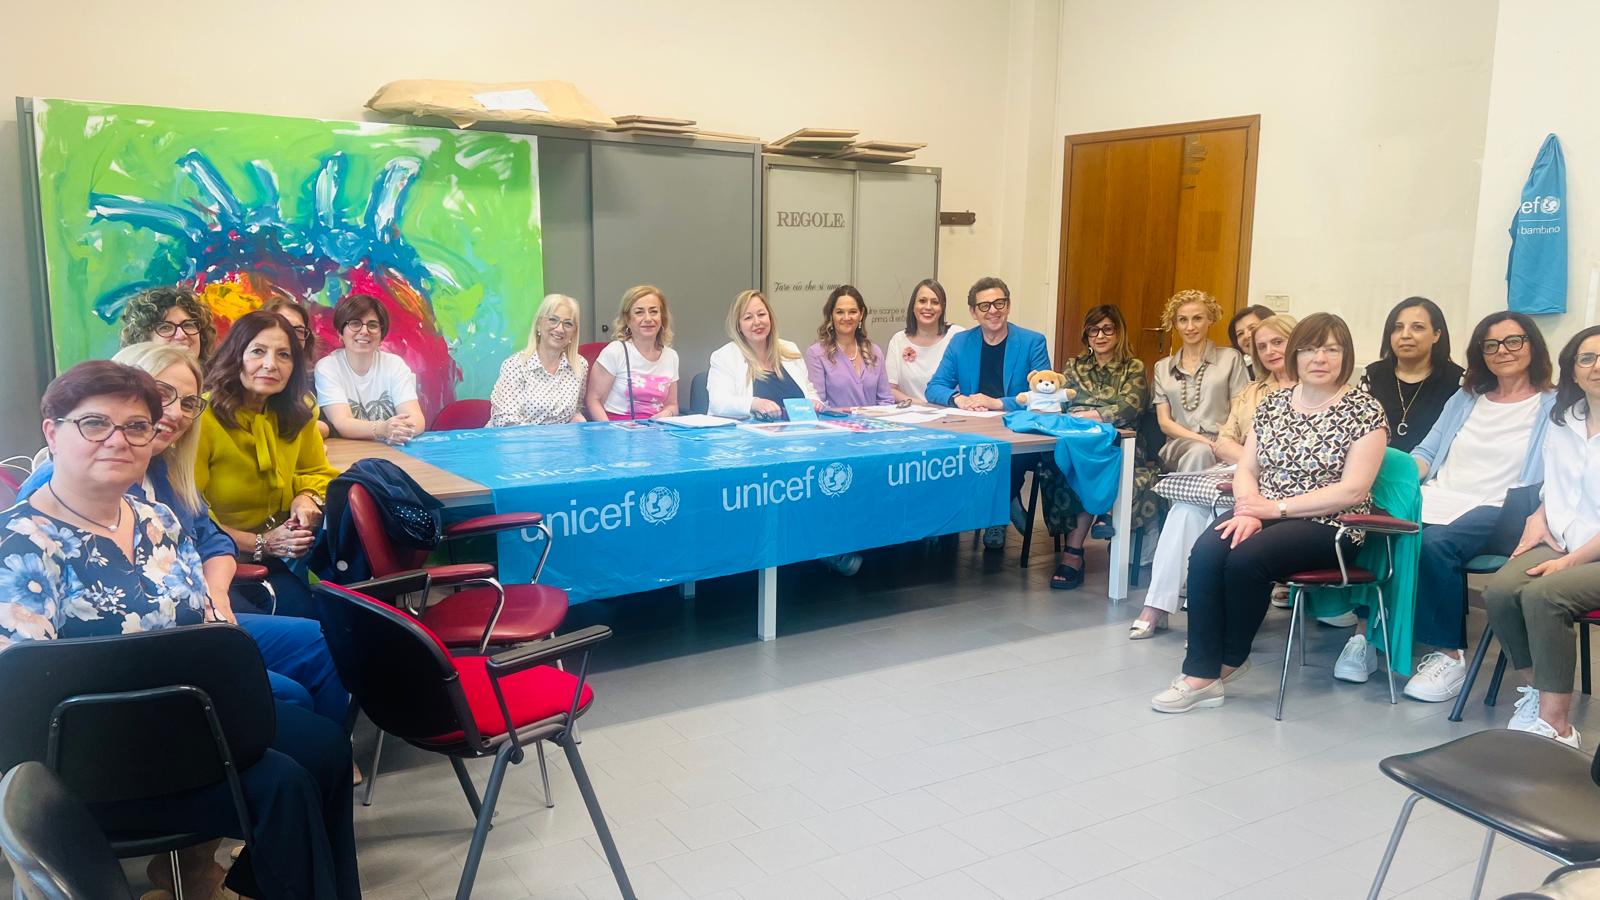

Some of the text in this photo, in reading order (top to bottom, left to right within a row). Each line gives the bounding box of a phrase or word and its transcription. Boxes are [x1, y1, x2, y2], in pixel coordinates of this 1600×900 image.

[1521, 226, 1560, 234] bambino
[888, 445, 967, 487] unicef
[722, 465, 816, 512] unicef
